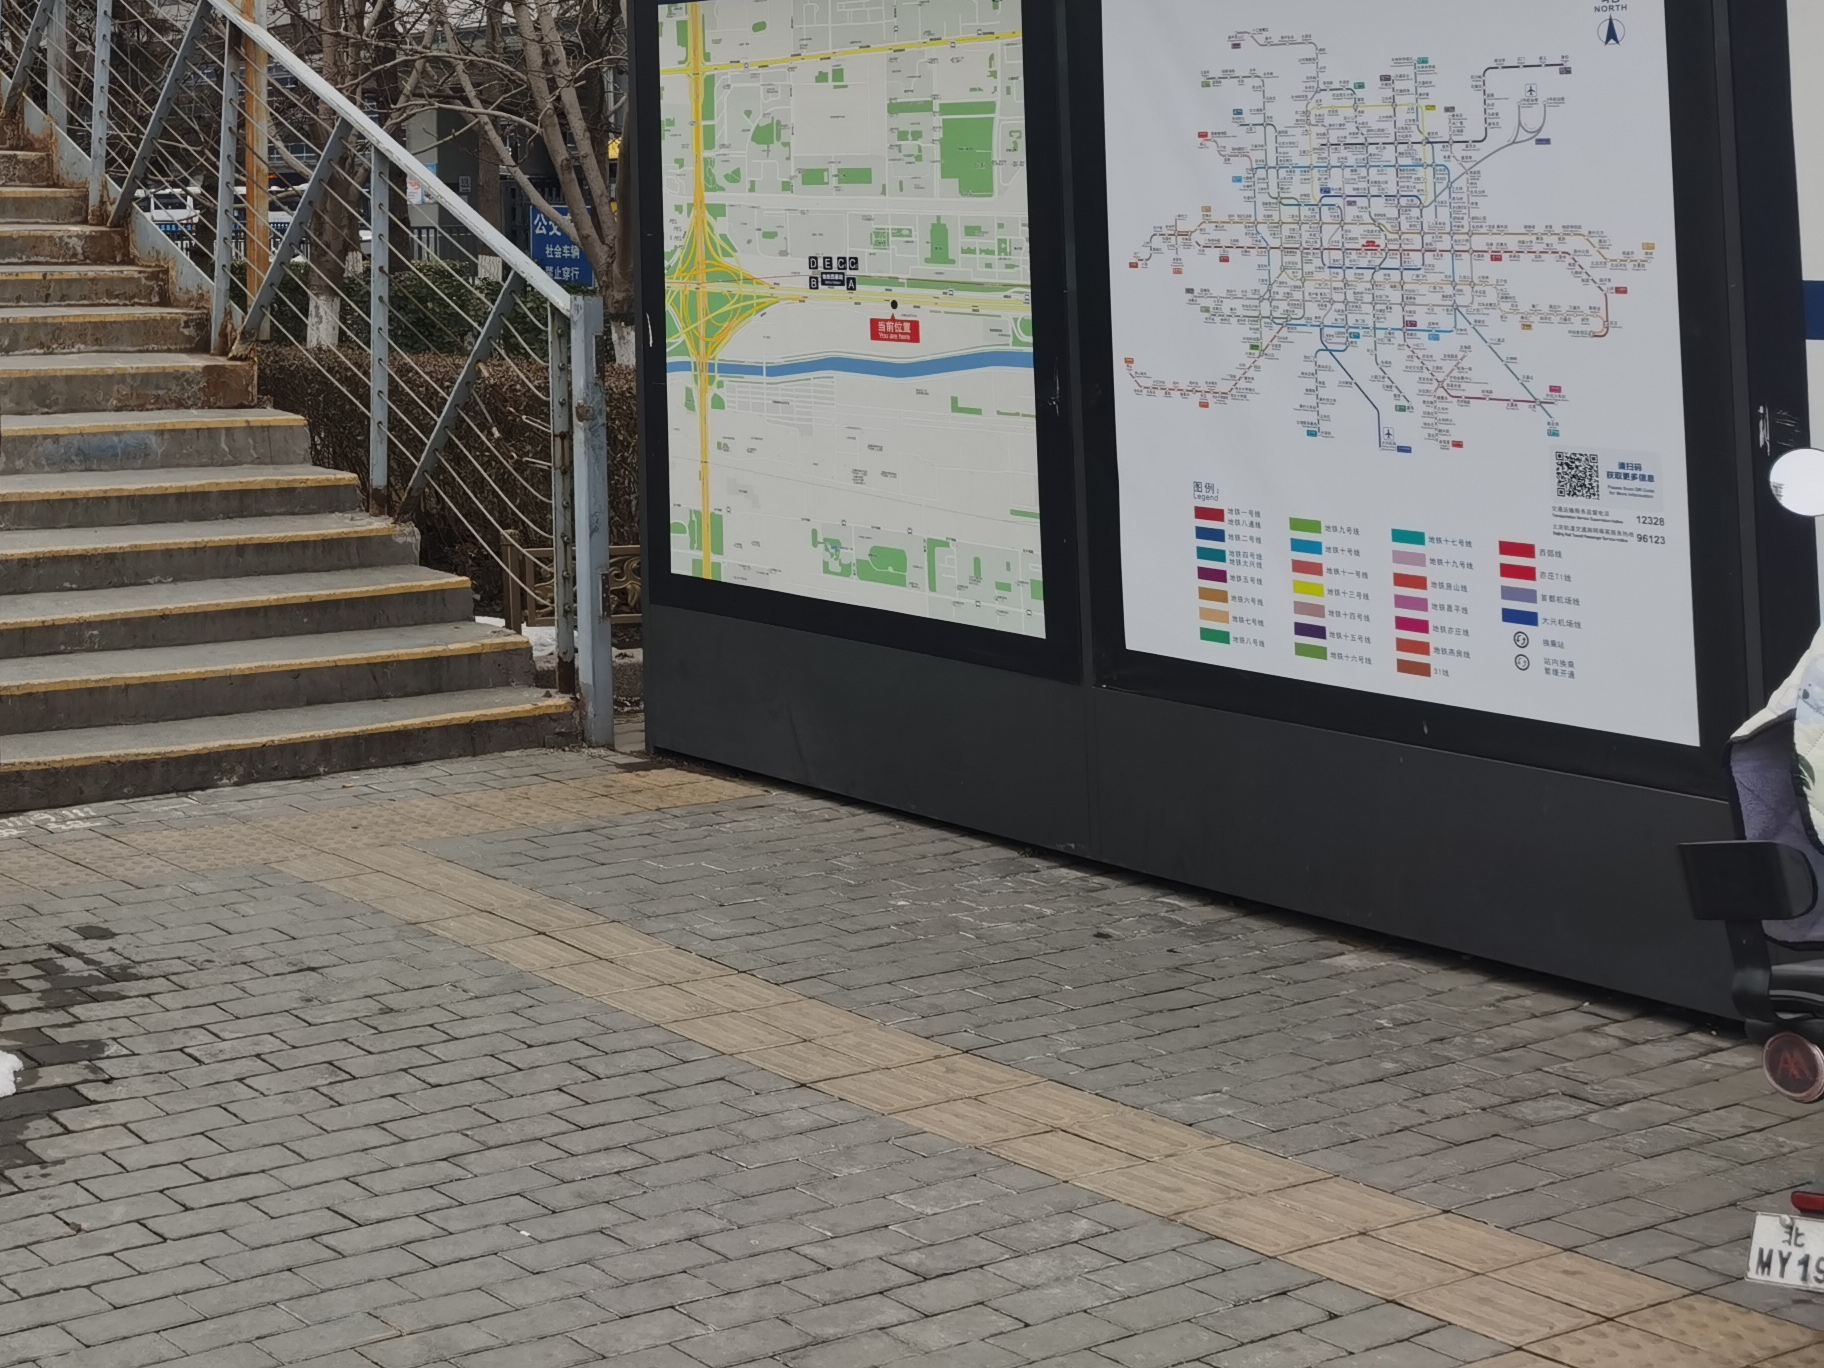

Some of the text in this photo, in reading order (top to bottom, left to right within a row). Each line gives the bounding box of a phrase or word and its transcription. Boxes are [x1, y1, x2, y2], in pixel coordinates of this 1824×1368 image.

[1594, 4, 1627, 13] NORTH
[545, 244, 580, 259] 社会车辆
[878, 321, 911, 333] 当前位置
[1193, 492, 1219, 501] Legend
[1227, 508, 1261, 518] 地铁一号线
[1227, 519, 1262, 529] 地铁八通线
[1636, 515, 1665, 527] 12328
[1325, 525, 1360, 535] 地铁九号线
[1228, 534, 1262, 544] 地铁二号线
[1428, 536, 1473, 548] 地铁十七号线
[1636, 533, 1666, 545] 96123
[1229, 550, 1263, 560] 地铁四号线
[1325, 546, 1361, 557] 地铁十号线
[1539, 548, 1563, 558] 西郊线
[1429, 558, 1474, 570] 地铁十九号线
[1326, 567, 1369, 579] 地铁十一号线
[1539, 571, 1572, 582] 亦庄T1线
[1230, 574, 1263, 585] 地铁五号线
[1430, 581, 1468, 593] 地铁房山线
[1327, 589, 1370, 600] 地铁十三号线
[1541, 594, 1581, 606] 首都机场线
[1231, 595, 1264, 606] 地铁六号线
[1431, 603, 1469, 615] 地铁昌平线
[1232, 616, 1265, 627] 地铁七号线
[1328, 610, 1371, 622] 地铁十四号线
[1432, 625, 1470, 637] 地铁亦庄线
[1233, 636, 1265, 647] 地铁八号线
[1329, 631, 1372, 644] 地铁十五号线
[1330, 652, 1372, 665] 地铁十六号线
